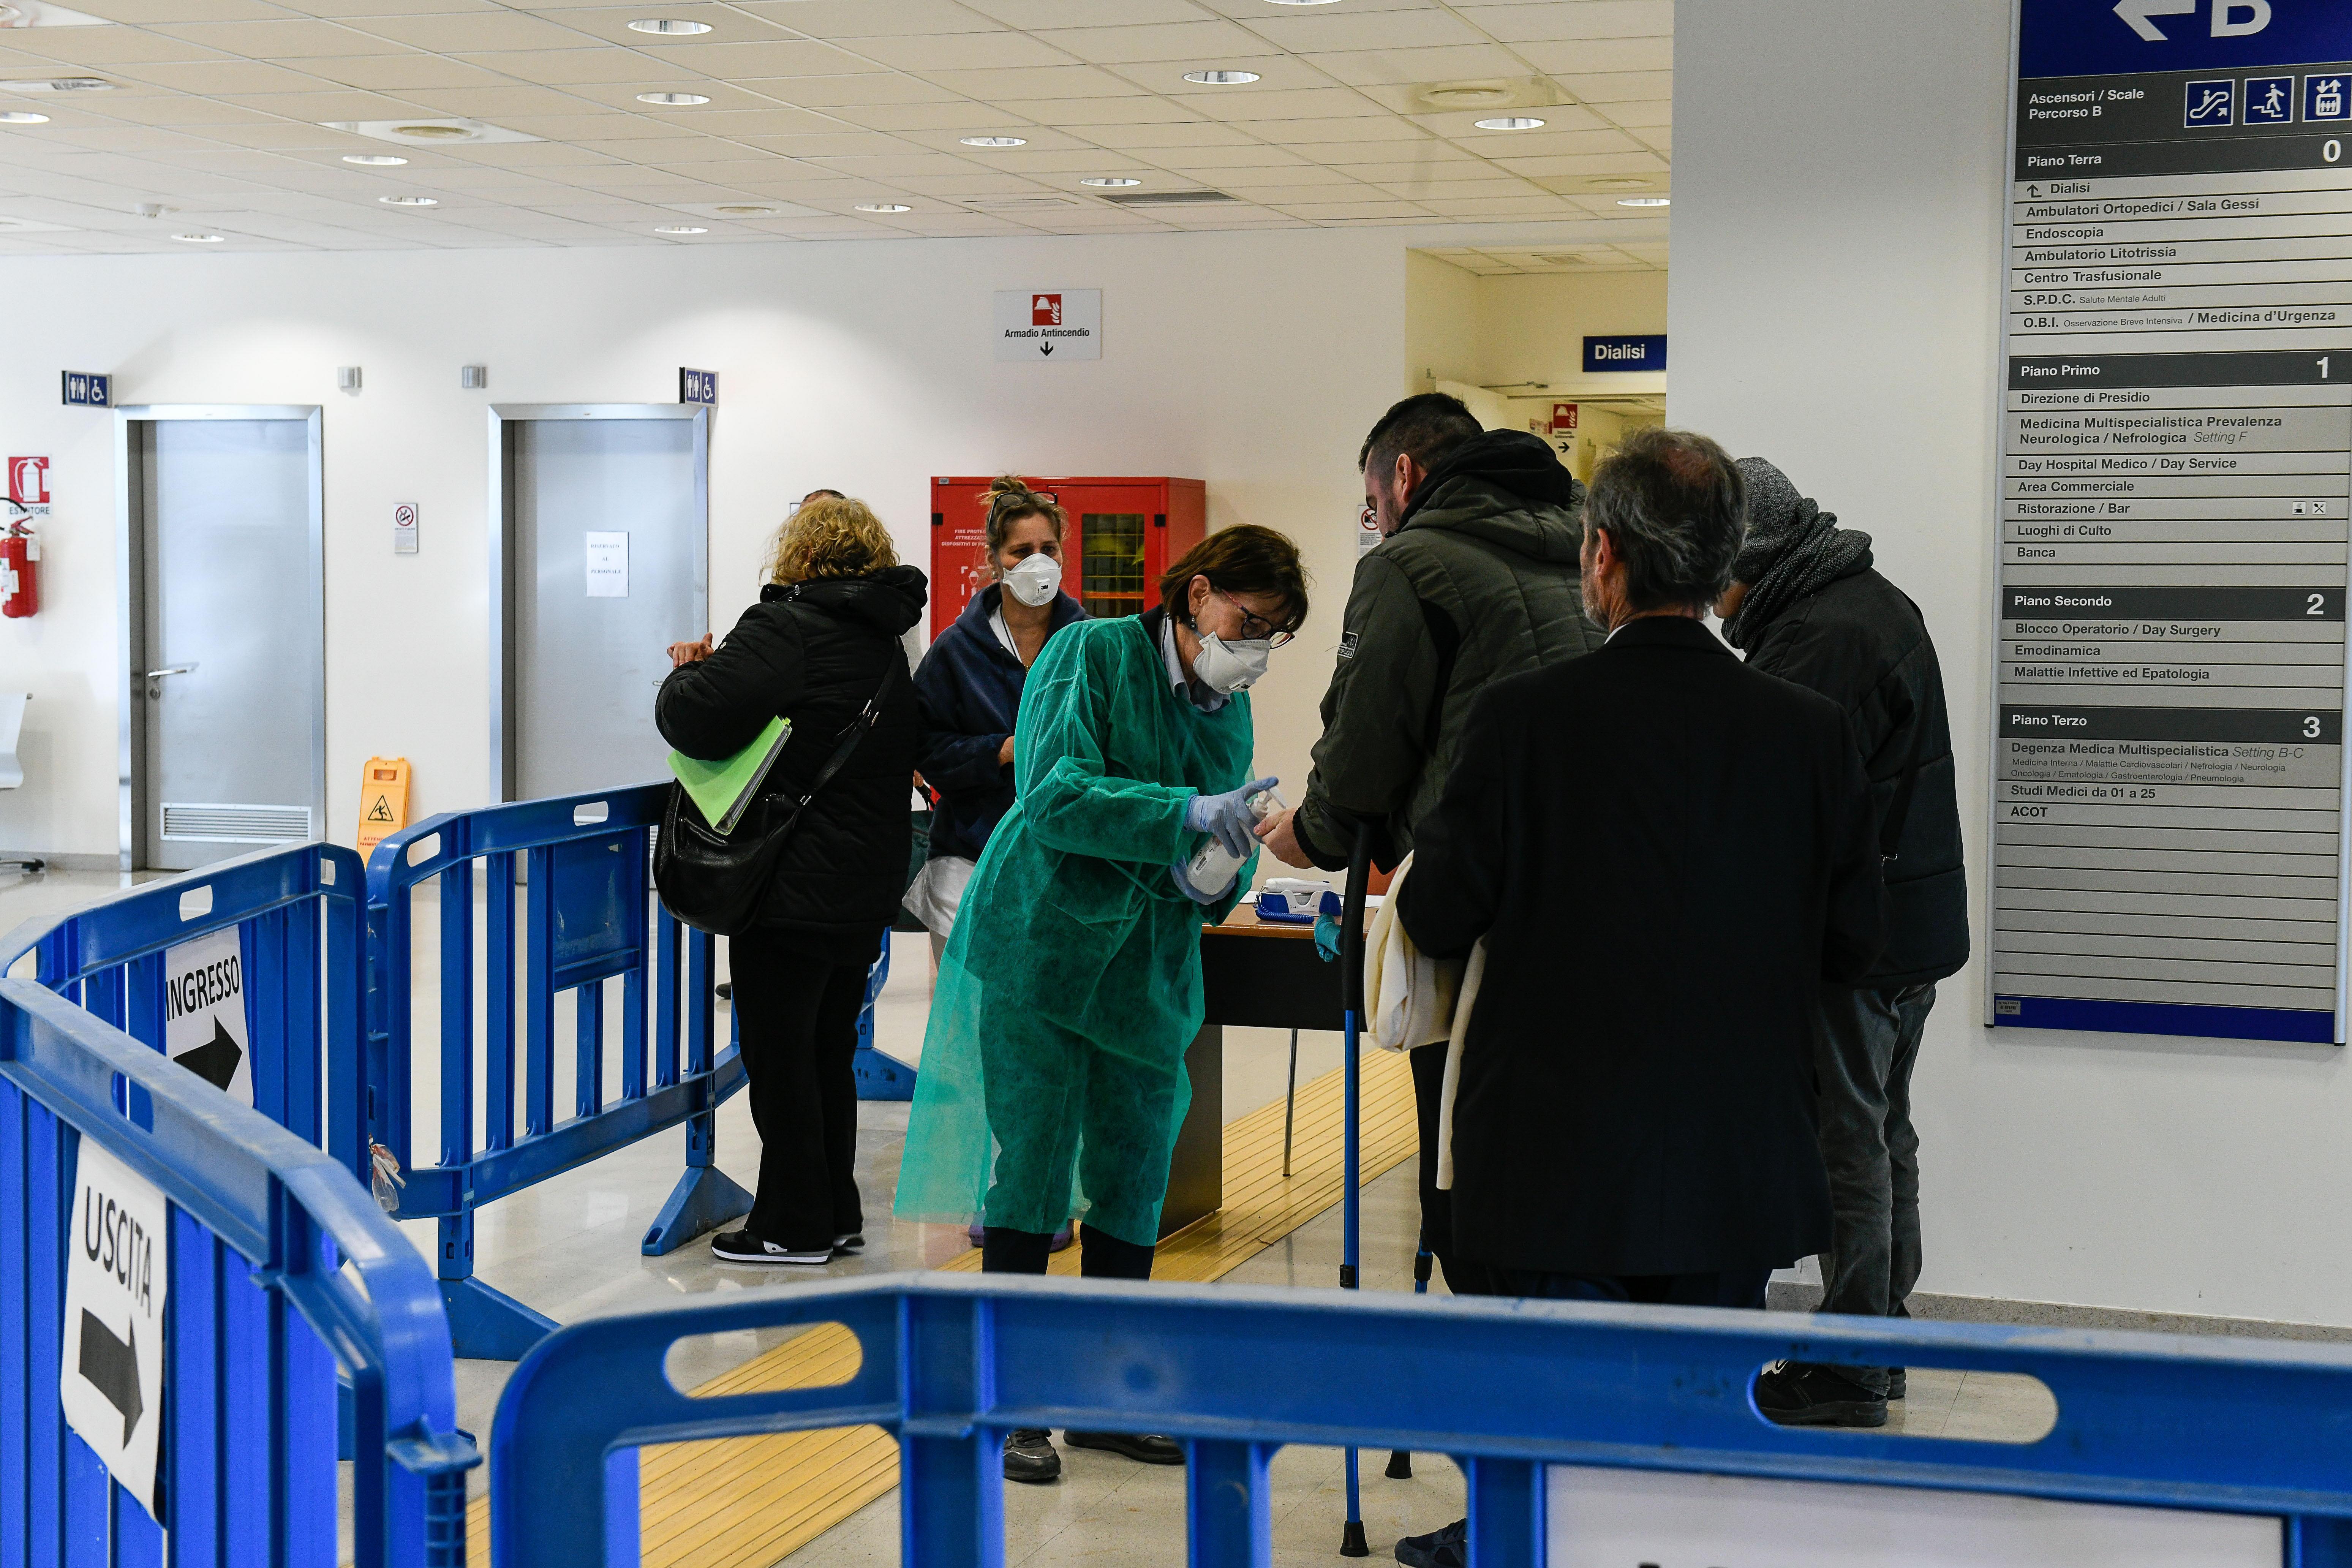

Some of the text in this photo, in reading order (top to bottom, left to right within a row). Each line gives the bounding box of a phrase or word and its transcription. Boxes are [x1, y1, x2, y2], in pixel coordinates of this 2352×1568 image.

[2029, 89, 2144, 104] Ascensori / Scale
[2029, 106, 2102, 119] Percorso B
[2323, 139, 2341, 162] 0
[2028, 154, 2101, 167] Piano Terra
[2050, 182, 2090, 194] Dialisi
[2026, 198, 2259, 217] Ambulatori Ortopedici / Sala Gessi
[2026, 227, 2103, 240] Endoscopia
[2025, 247, 2176, 261] Ambulatorio Litotrissia
[2024, 269, 2161, 283] Centro Trasfusionale
[2023, 294, 2075, 305] S.P.D.C.
[2023, 317, 2059, 328] O.B.I.
[2188, 313, 2194, 324] /
[2197, 311, 2260, 323] Medicina
[1005, 328, 1090, 337] Armadio Antincendio
[1595, 344, 1645, 359] Dialisi
[2021, 365, 2100, 376] Piano Primo
[2316, 357, 2328, 378] 1
[2022, 392, 2150, 404] Direzione di Presidio
[2020, 416, 2281, 430] Medicina Multispecialistica Prevalenza
[2020, 431, 2248, 446] Neurologica / Nefrologica Setting F
[2019, 458, 2237, 472] Day Hospital Medico / Day Service
[2018, 481, 2134, 492] Area Commerciale
[2018, 503, 2130, 514] Ristorazione / Bar
[2018, 525, 2112, 538] Luoghi di Culto
[2017, 547, 2055, 557] Banca
[2015, 595, 2112, 606] Piano Secondo
[2306, 593, 2324, 615] 2
[2016, 623, 2221, 637] Blocco Operatorio / Day Surgery
[2015, 645, 2100, 656] Emodinamica
[2015, 667, 2209, 681] Malattie Infettive ed Epatologia
[2012, 714, 2087, 726] Piano Terzo
[2303, 716, 2320, 738] 3
[2012, 742, 2304, 760] Degenza Medica Multispecialistica Setting B-C
[2012, 758, 2048, 767] Medicina
[2050, 759, 2078, 767] Interna
[2120, 760, 2182, 769] Cardiovascolari
[2191, 762, 2232, 772] Nefrologia
[2241, 763, 2286, 773] Neurologia
[2011, 769, 2051, 780] Oncologia
[2052, 770, 2057, 778] /
[2059, 770, 2103, 780] Ematologia
[2110, 771, 2183, 782] Gastroenterologia
[2191, 774, 2244, 784] Pneumologia
[2011, 785, 2042, 795] Studi
[2047, 786, 2088, 797] Medici
[2092, 787, 2107, 797] da
[2111, 787, 2124, 798] 01
[2140, 789, 2155, 798] 25
[2011, 806, 2048, 817] ACOT
[166, 954, 240, 1022] INGRESSO
[85, 1185, 152, 1319] USCITA
